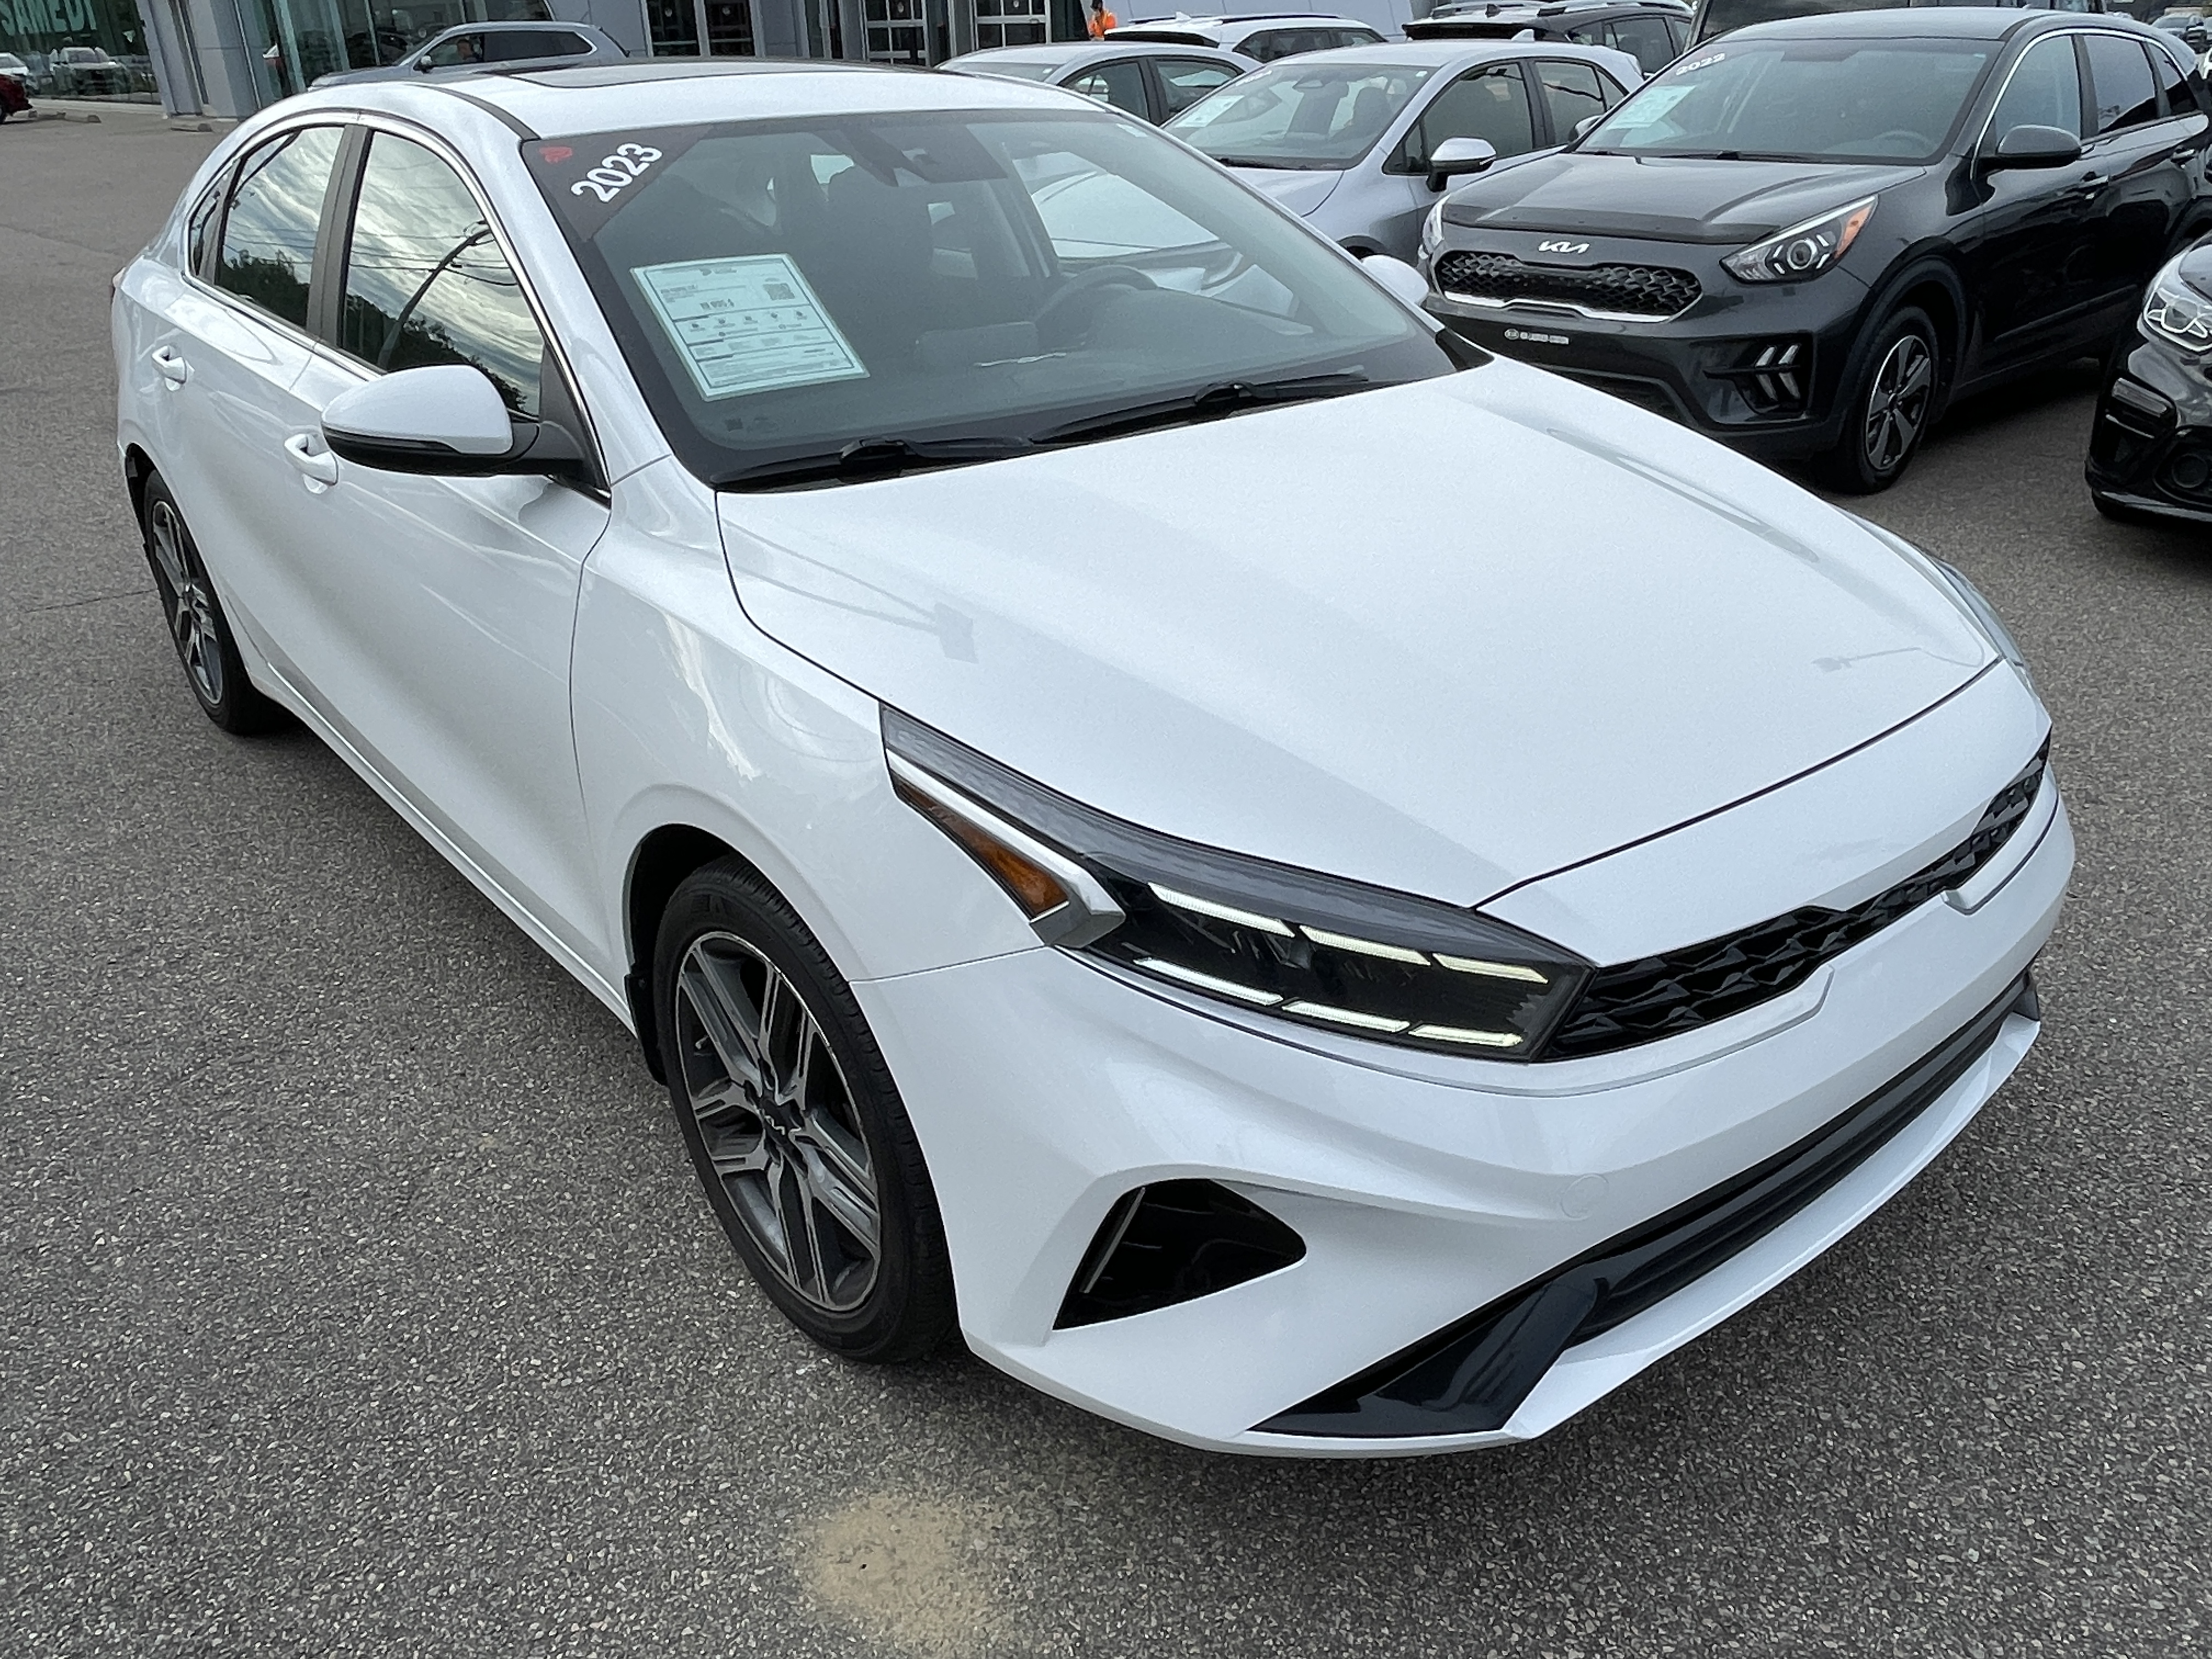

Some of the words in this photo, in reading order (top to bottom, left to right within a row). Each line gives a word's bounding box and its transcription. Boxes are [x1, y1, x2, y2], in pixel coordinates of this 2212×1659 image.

[1676, 53, 1725, 76] 2022
[571, 143, 663, 202] 2023
[1538, 240, 1590, 253] KIA
